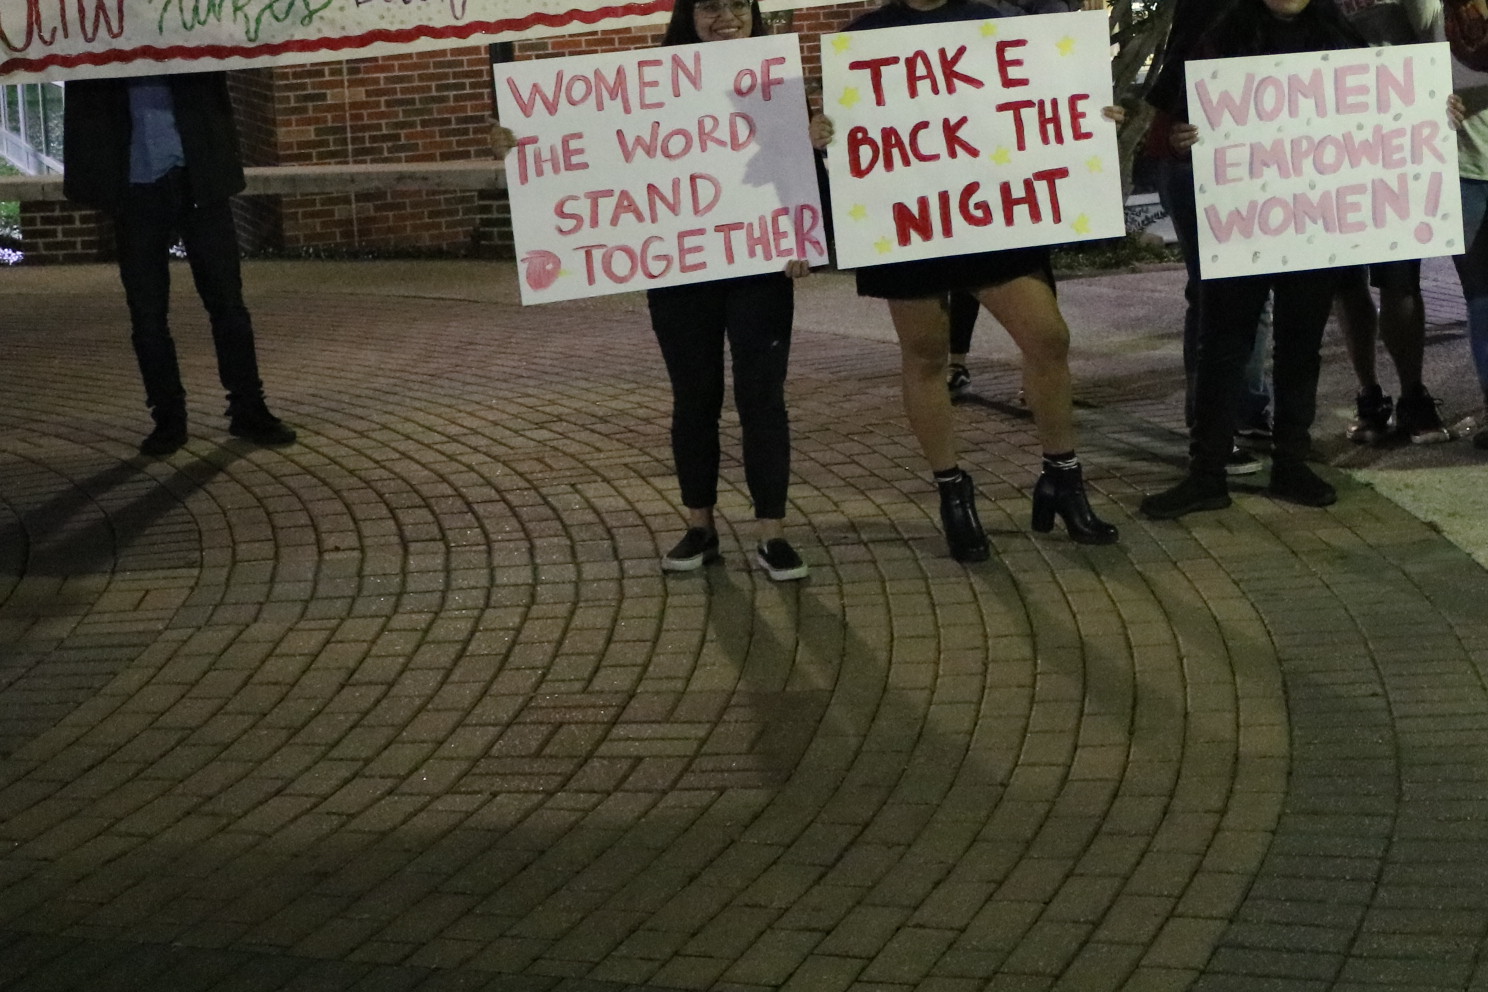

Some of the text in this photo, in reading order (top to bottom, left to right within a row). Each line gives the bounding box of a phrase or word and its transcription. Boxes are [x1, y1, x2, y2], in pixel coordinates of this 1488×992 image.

[506, 51, 786, 118] WOMEN OF
[848, 38, 1029, 107] TAKE
[1195, 56, 1416, 131] WOMEN
[517, 112, 757, 185] THE WORD
[847, 93, 1094, 179] BACK THE
[1213, 120, 1447, 186] EMPOWER
[554, 172, 722, 236] STAND
[892, 166, 1070, 247] NIGHT
[1203, 171, 1443, 245] WOMEN!
[572, 203, 825, 287] TOGETHER
